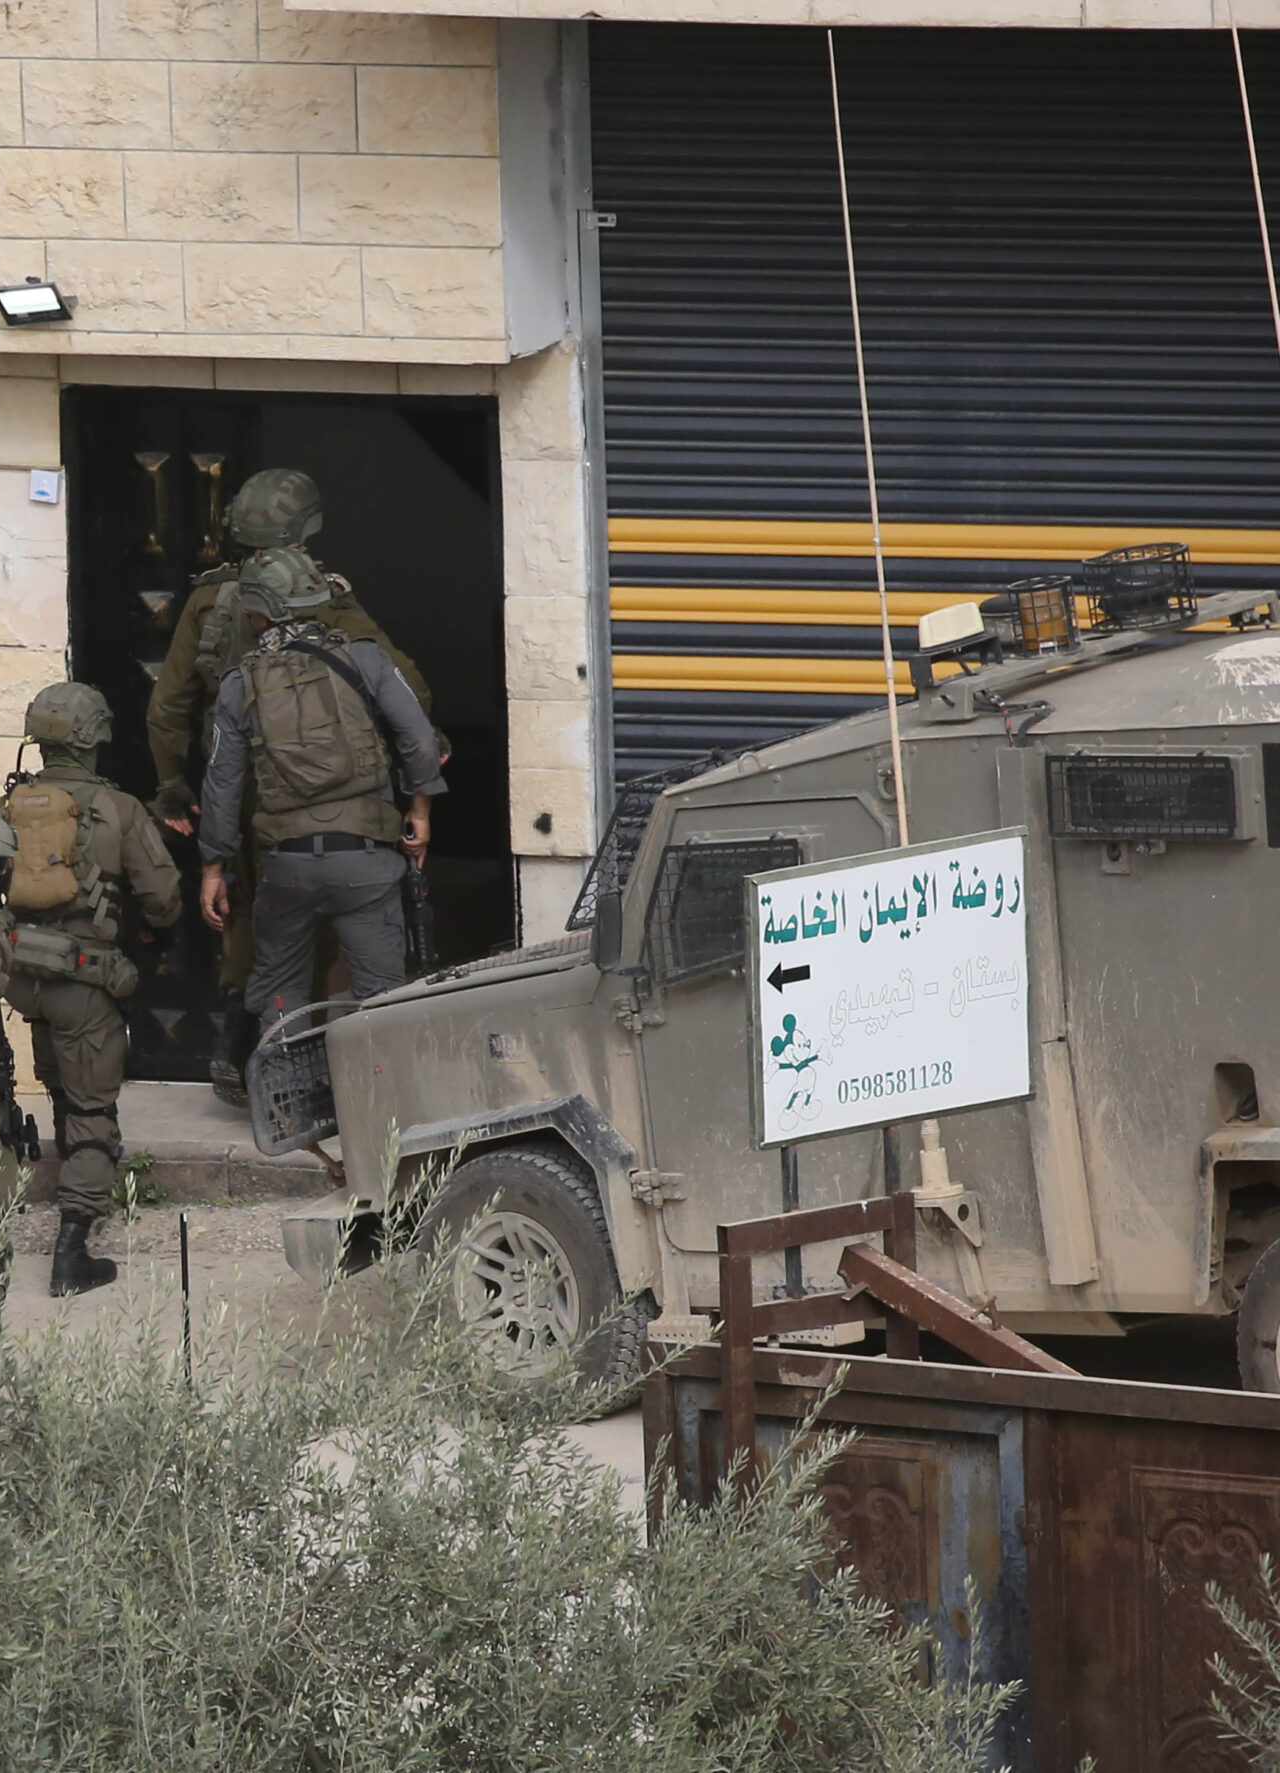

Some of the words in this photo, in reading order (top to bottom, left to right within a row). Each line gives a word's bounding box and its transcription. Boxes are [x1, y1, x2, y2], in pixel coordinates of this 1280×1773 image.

[760, 888, 846, 945] الخاصة
[858, 869, 938, 943] الإيمان
[949, 860, 1021, 918] روضة
[828, 968, 915, 1047] تمهيدي
[949, 955, 1021, 1018] بستان
[837, 1060, 953, 1105] 0598581128
